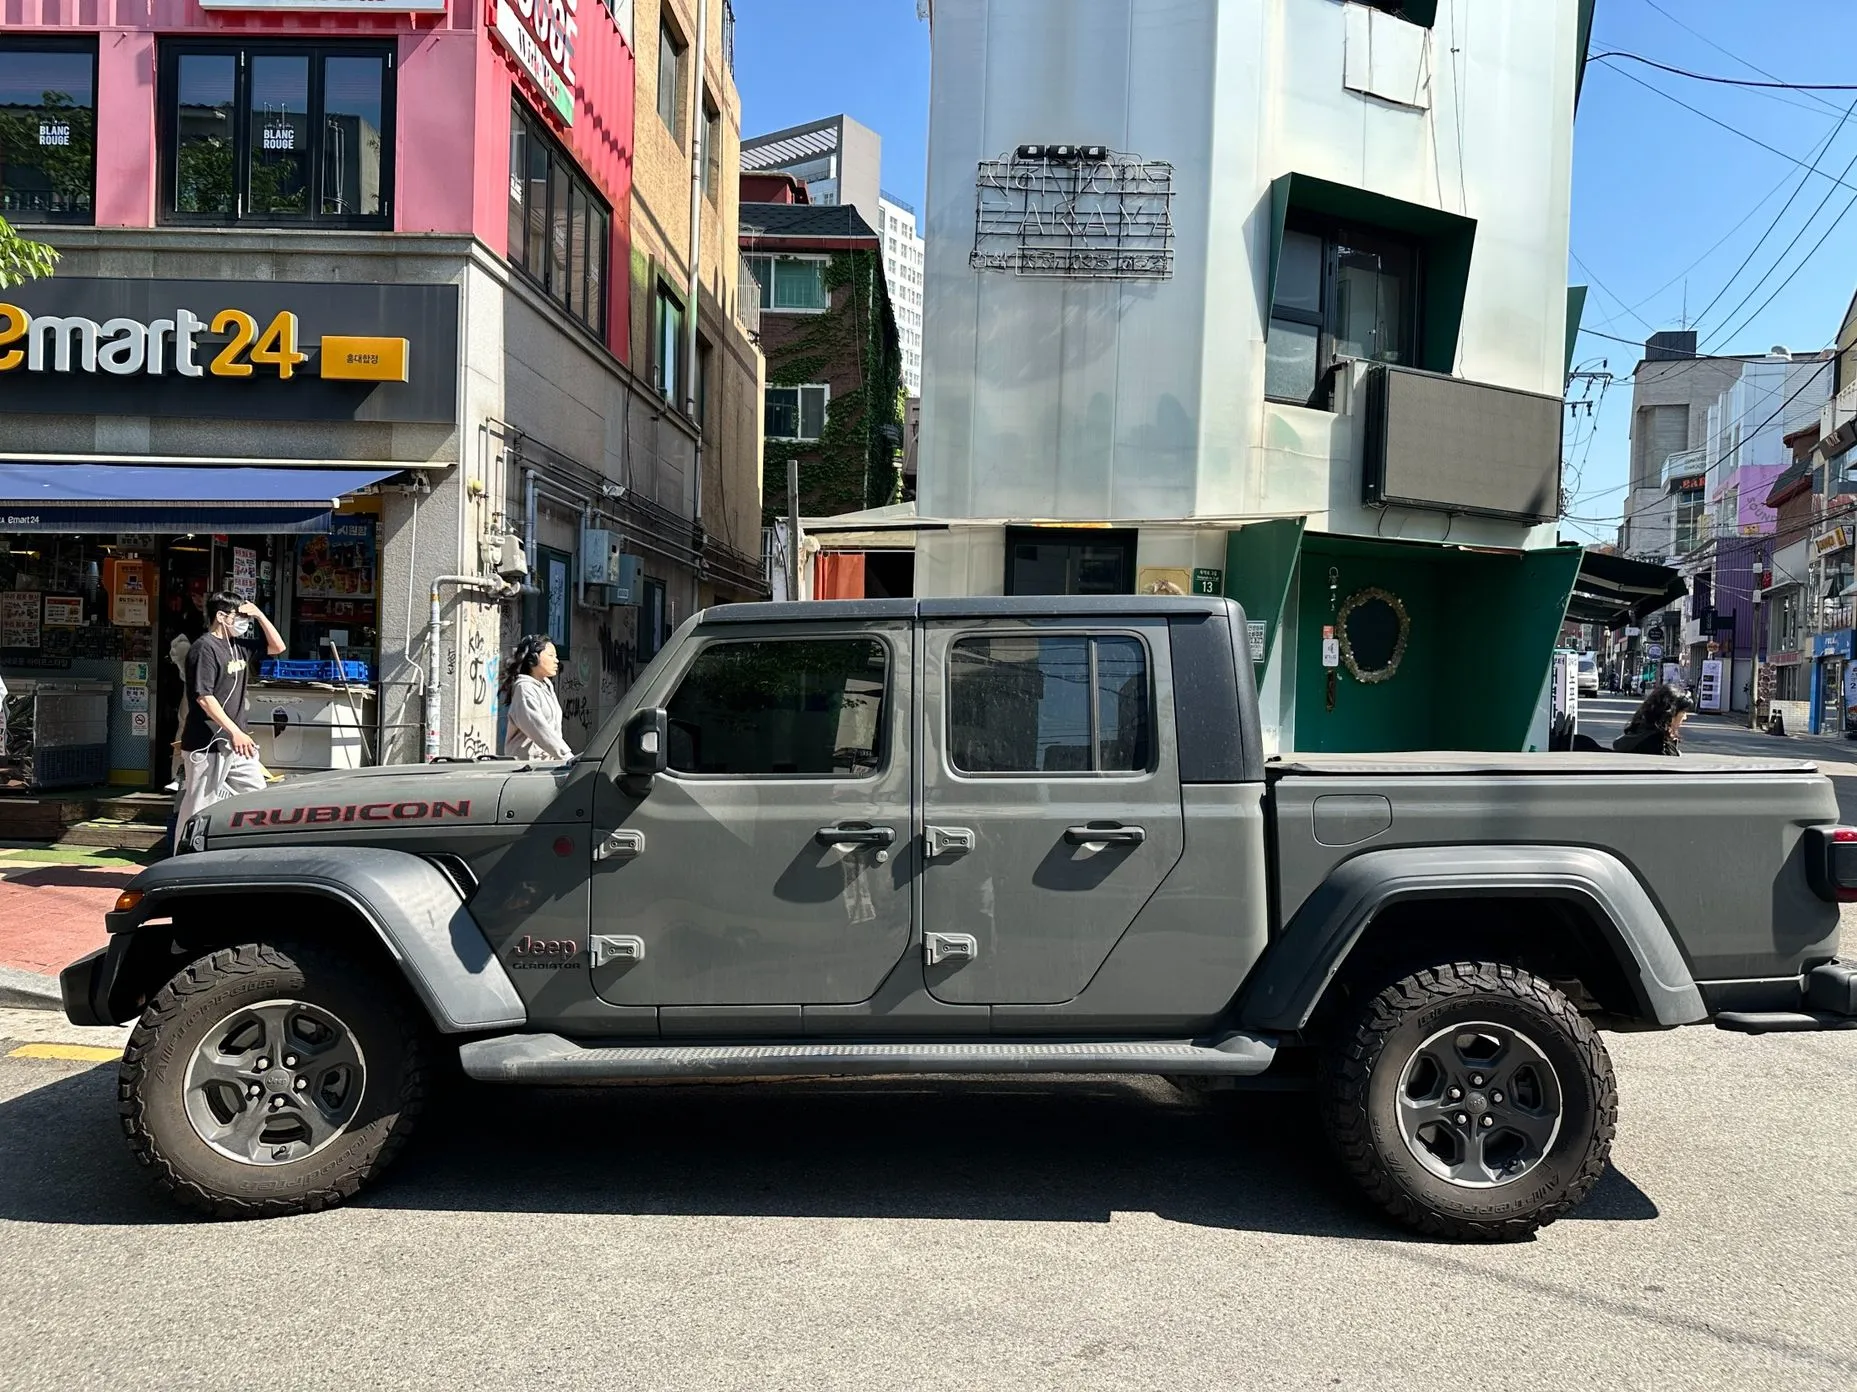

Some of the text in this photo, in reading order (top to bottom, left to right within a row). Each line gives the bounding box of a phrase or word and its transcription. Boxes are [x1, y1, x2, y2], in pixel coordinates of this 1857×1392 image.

[40, 125, 69, 135] BLANC
[264, 130, 294, 139] BLANC
[39, 136, 69, 145] ROUGE
[264, 140, 294, 149] ROUGE
[0, 304, 308, 379] emart24
[346, 353, 379, 364] 홍대합정
[8, 516, 40, 524] emart24
[1202, 581, 1213, 593] 13
[230, 800, 471, 828] RUBICON
[513, 935, 576, 960] Jeep
[512, 961, 581, 970] GLADIATOR
